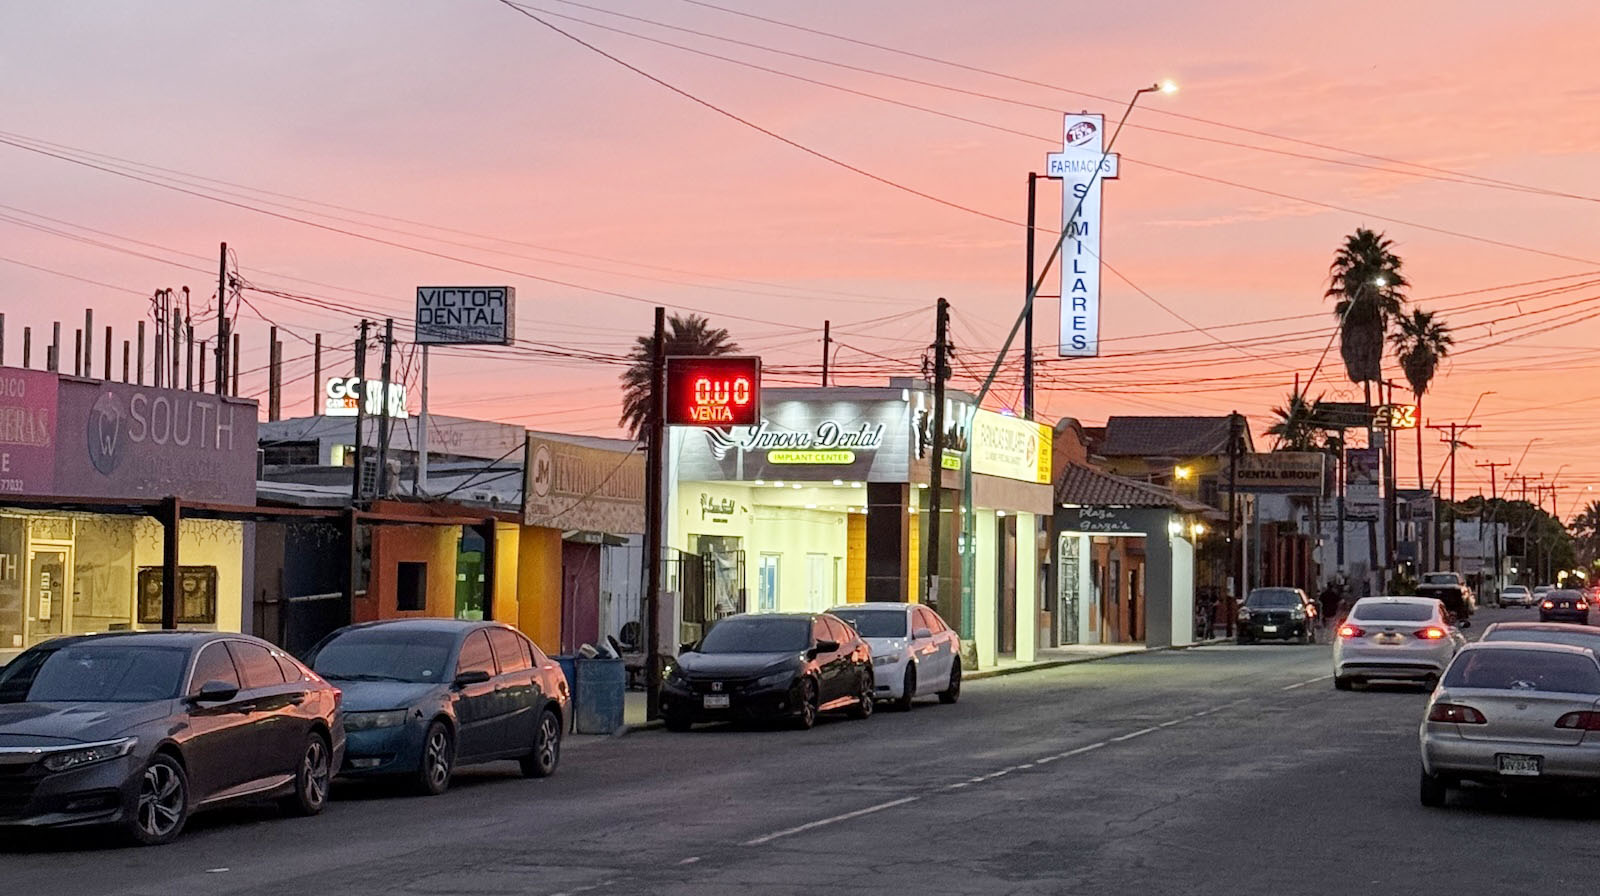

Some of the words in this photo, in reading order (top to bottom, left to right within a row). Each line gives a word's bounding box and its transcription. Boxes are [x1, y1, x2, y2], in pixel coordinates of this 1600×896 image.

[1051, 160, 1111, 173] FARMACIAS
[1071, 183, 1089, 350] SIMILARES
[419, 290, 503, 307] VICTOR
[418, 307, 503, 325] DENTAL
[128, 392, 235, 450] SOUTH
[689, 406, 734, 421] VENTA
[741, 422, 811, 447] Innova
[814, 421, 883, 447] Dental
[774, 453, 813, 461] IMPLANT
[815, 453, 849, 461] CENTER
[1238, 470, 1278, 479] DENTAL
[1280, 471, 1320, 480] GROUP
